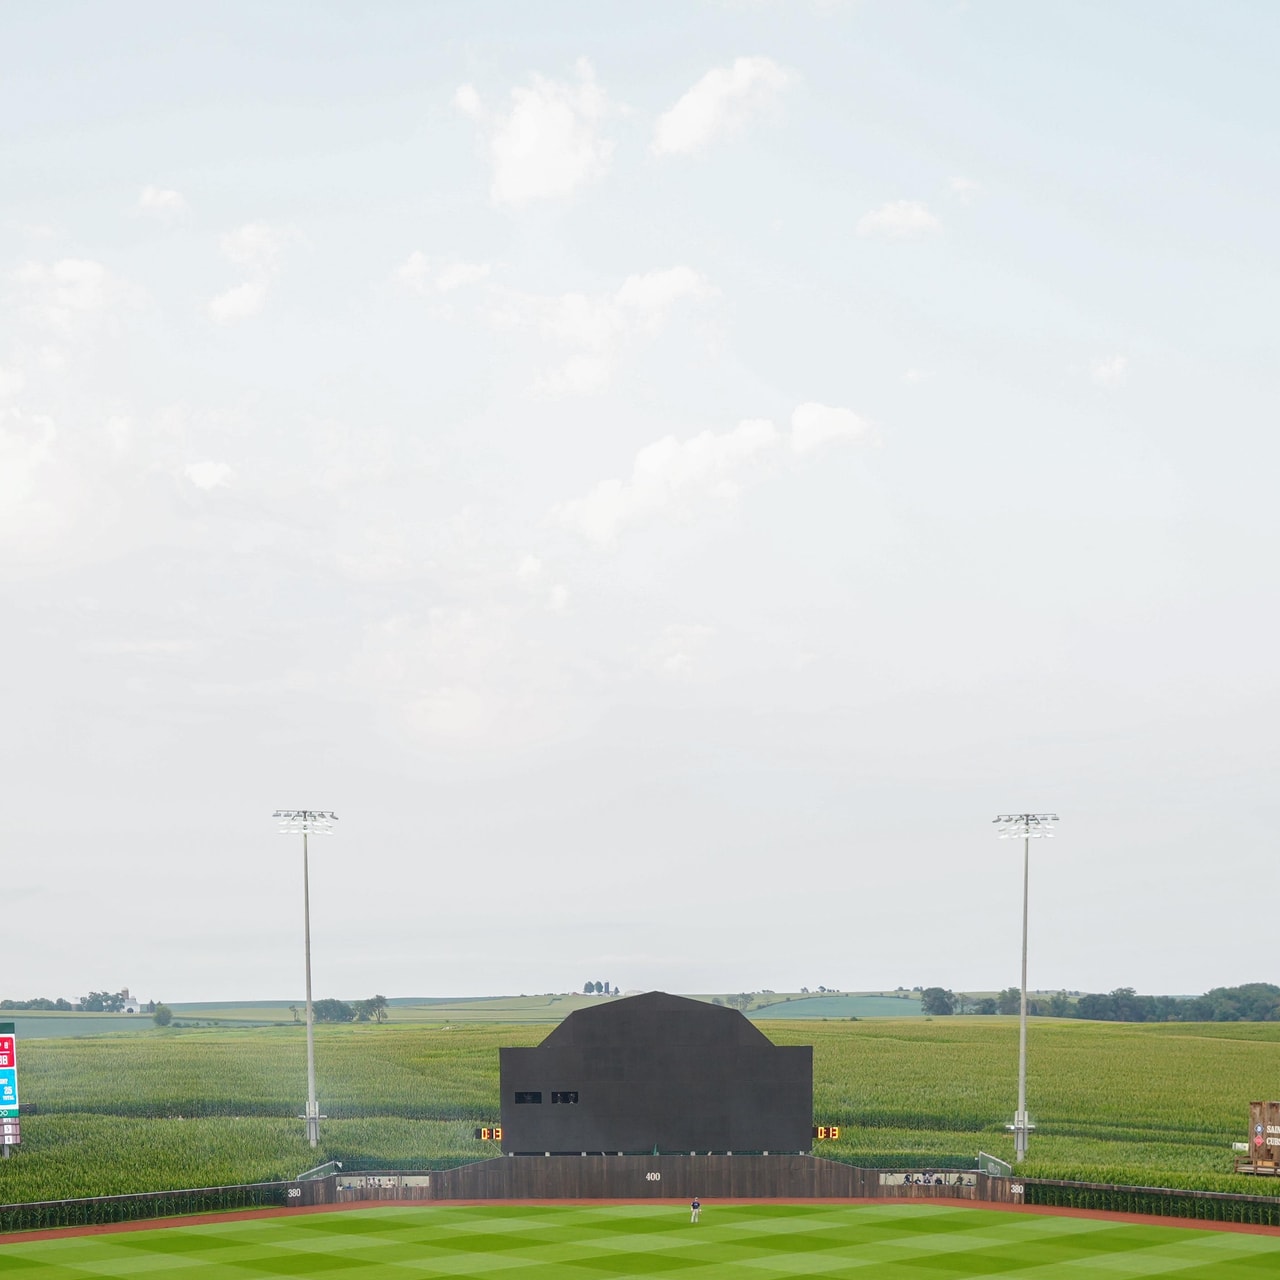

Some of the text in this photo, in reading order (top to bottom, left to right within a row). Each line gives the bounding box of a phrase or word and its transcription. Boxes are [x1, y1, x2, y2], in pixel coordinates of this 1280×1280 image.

[481, 1127, 502, 1140] 0:13
[818, 1126, 839, 1139] 0:13
[646, 1172, 660, 1181] 400
[288, 1188, 300, 1197] 380
[1011, 1184, 1023, 1194] 380
